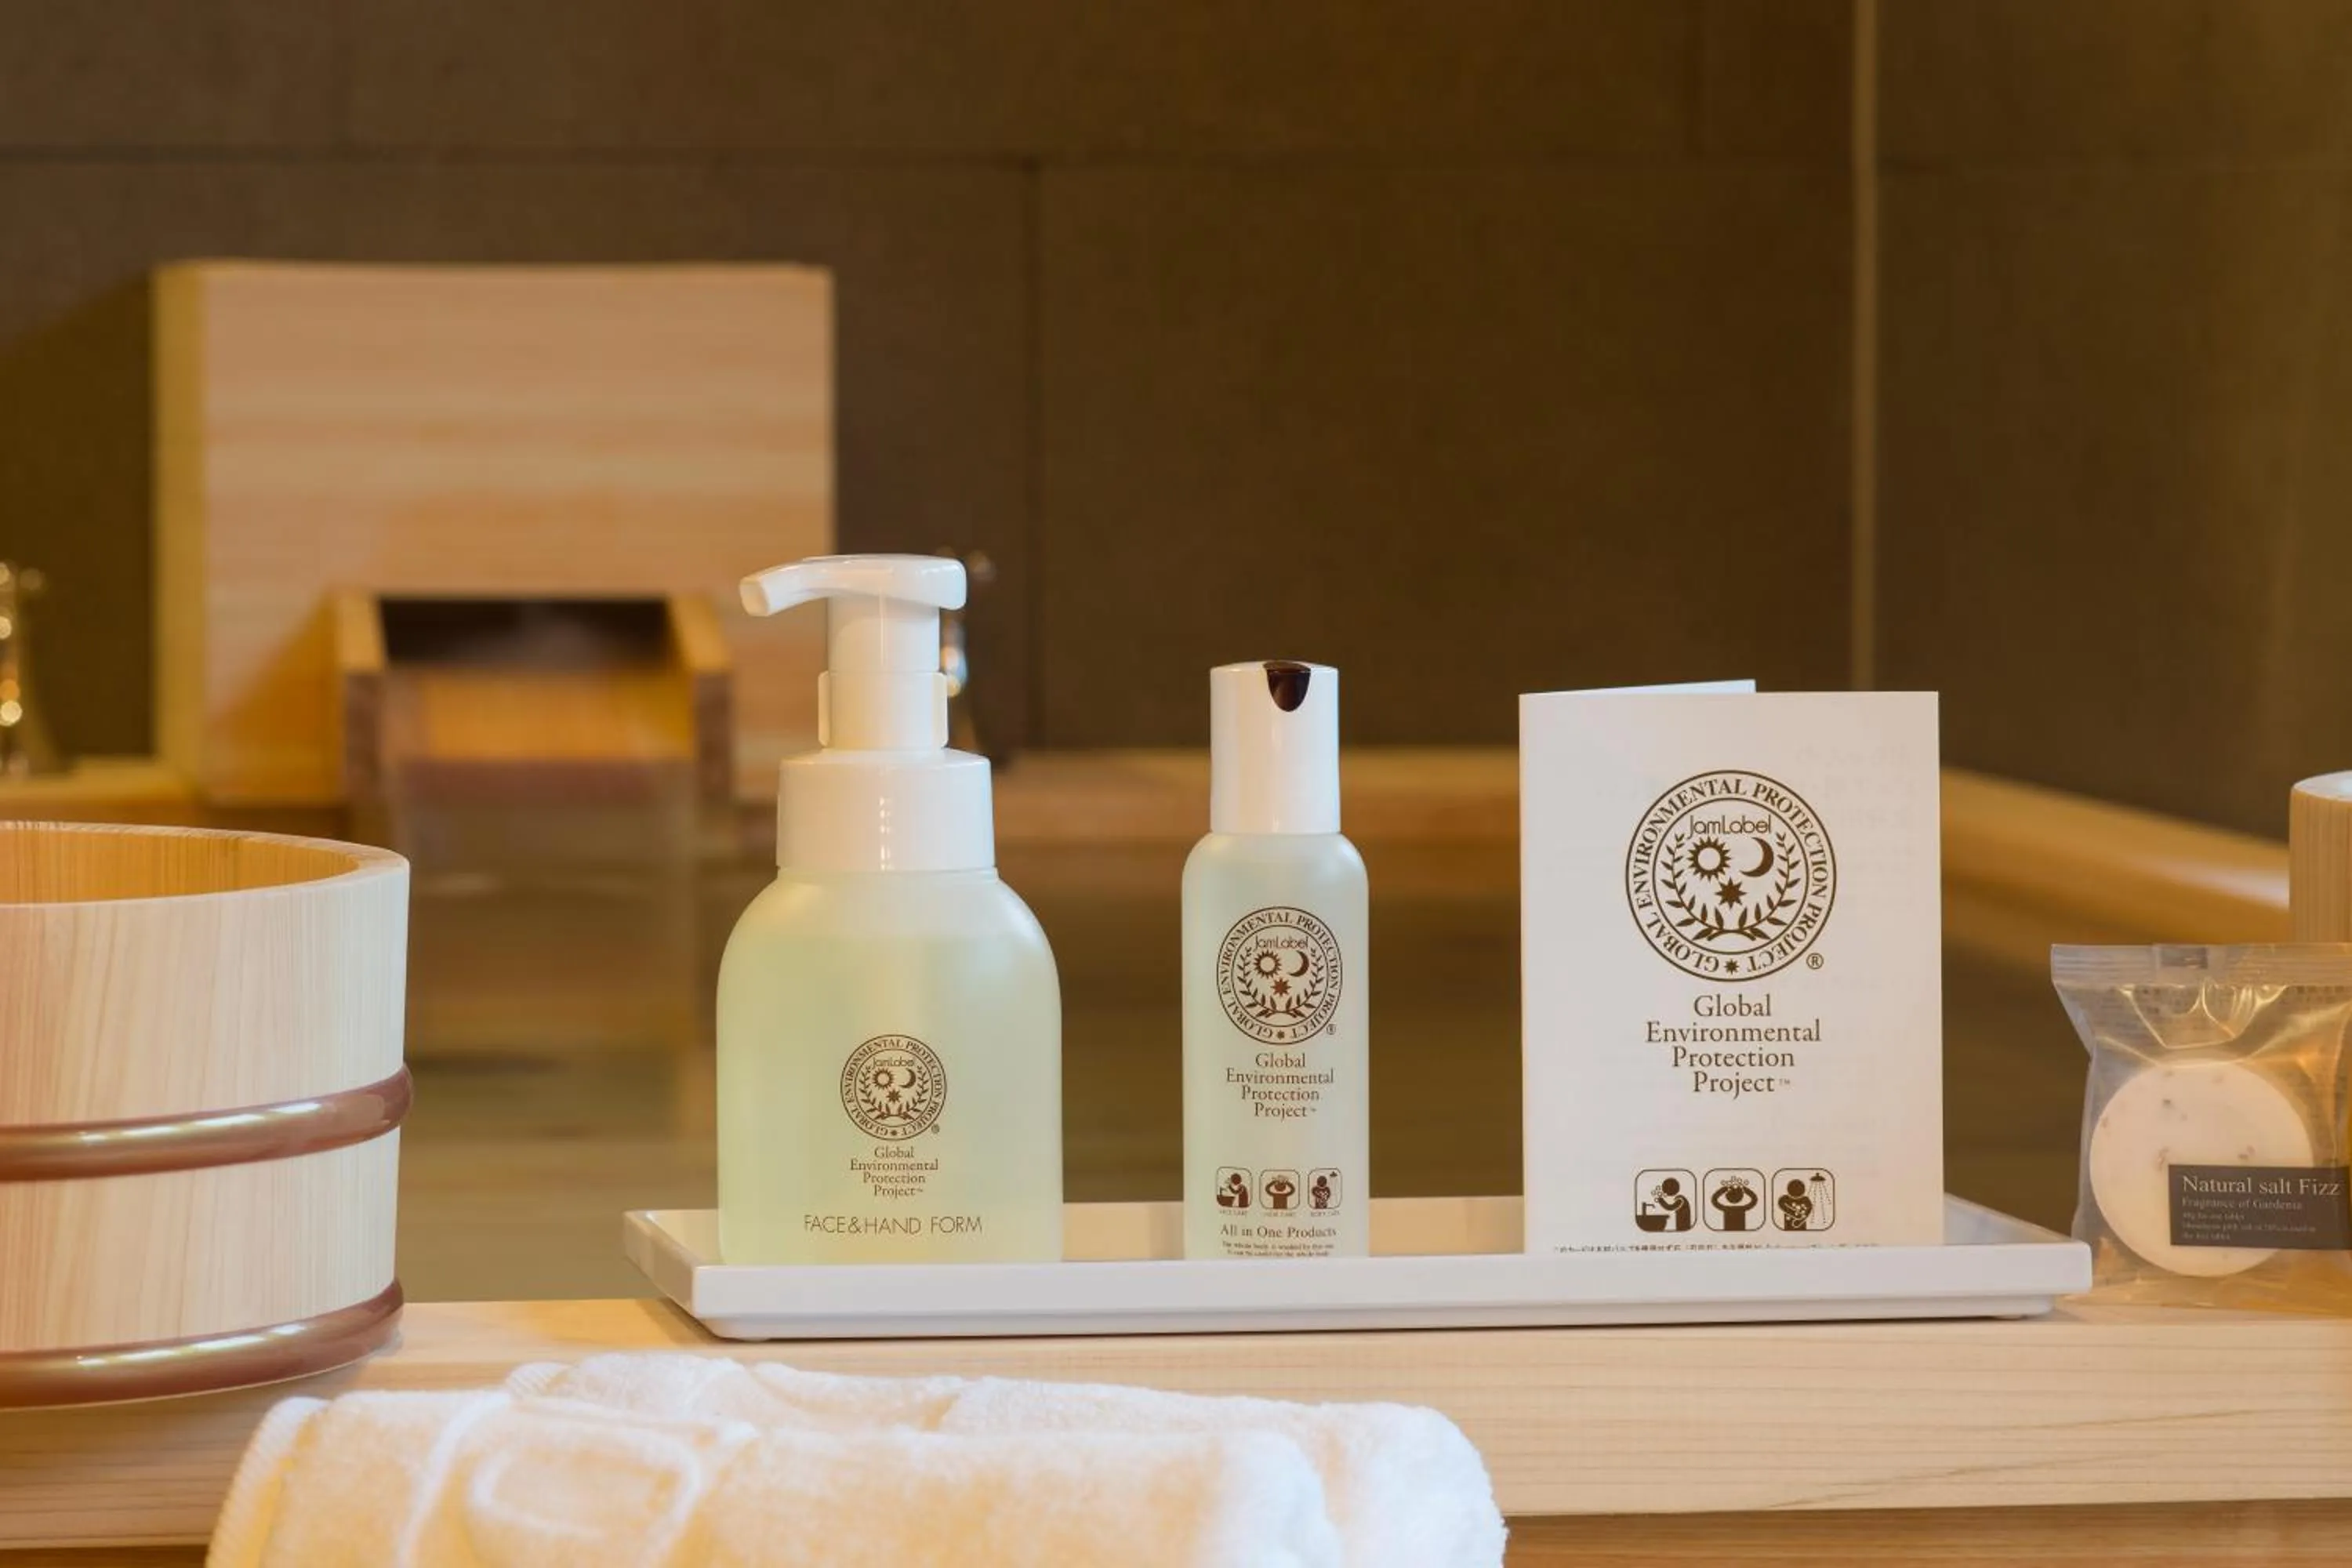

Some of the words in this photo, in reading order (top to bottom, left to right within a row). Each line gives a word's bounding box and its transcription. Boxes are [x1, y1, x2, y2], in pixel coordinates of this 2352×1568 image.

[1687, 815, 1771, 838] JamLabel
[1631, 778, 1747, 909] ENVIRONMENTAL
[1752, 783, 1828, 902] PROTECTION
[1646, 912, 1720, 973] GLOBAL
[1747, 906, 1822, 973] PROJECT
[1221, 912, 1293, 996] ENVIRONMENTAL
[1296, 915, 1338, 989] PROTECTION
[1693, 994, 1771, 1018] Global
[1646, 1019, 1821, 1043] Environmental
[1255, 1052, 1306, 1068] Global
[1672, 1047, 1795, 1068] Protection
[1226, 1068, 1334, 1084] Environmental
[1693, 1071, 1775, 1099] Project
[1241, 1085, 1320, 1102] Protection
[1254, 1102, 1308, 1122] Project
[874, 1147, 914, 1159] Global
[850, 1159, 938, 1171] Environmental
[862, 1172, 926, 1184] Protection
[2182, 1175, 2252, 1193] Natural
[2259, 1178, 2292, 1195] salt
[2299, 1178, 2341, 1196] Fizz
[804, 1215, 922, 1235] FACE&HAND
[931, 1216, 983, 1235] FORM
[1220, 1224, 1238, 1236] All
[1241, 1226, 1253, 1237] in
[1257, 1226, 1283, 1238] One
[1287, 1225, 1338, 1240] Products
